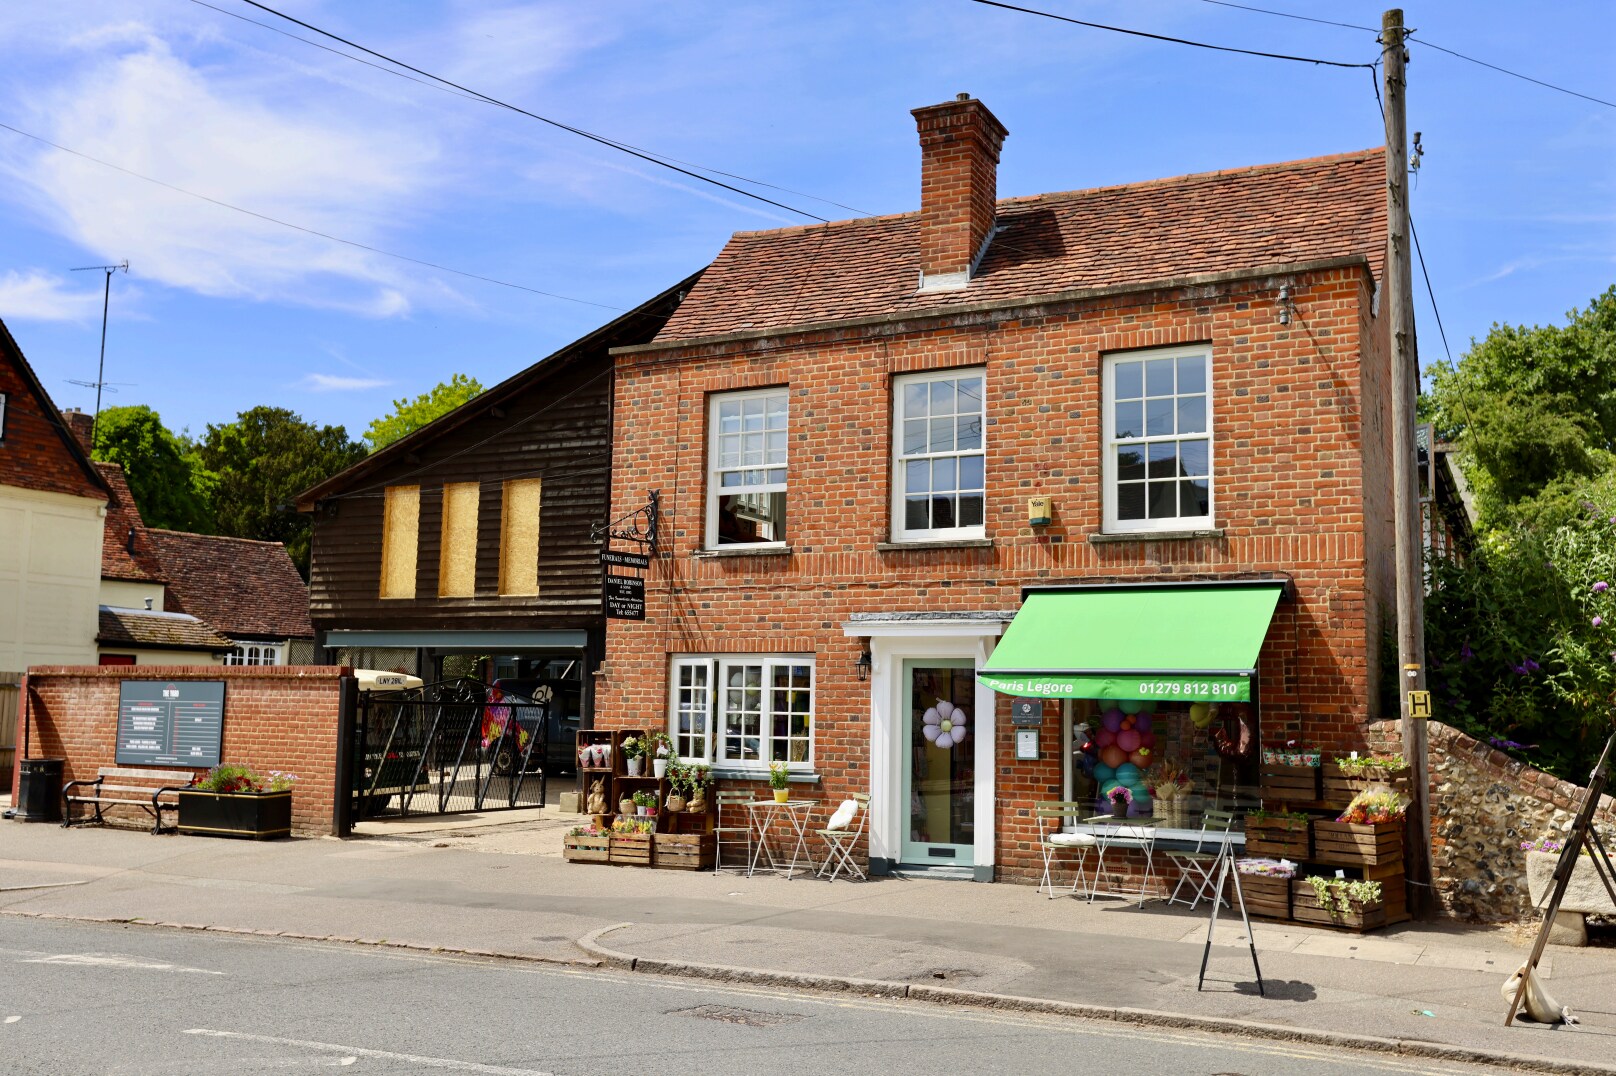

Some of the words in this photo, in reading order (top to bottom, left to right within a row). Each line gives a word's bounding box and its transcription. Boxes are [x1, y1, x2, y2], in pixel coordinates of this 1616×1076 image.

[602, 554, 622, 562] FUNERALS
[624, 556, 648, 566] MEMORIALS
[989, 679, 1024, 692] Paris
[1027, 680, 1074, 695] Legore
[1139, 682, 1180, 695] 01279
[1183, 683, 1209, 695] 812
[1212, 683, 1237, 695] 810
[1412, 694, 1428, 714] H
